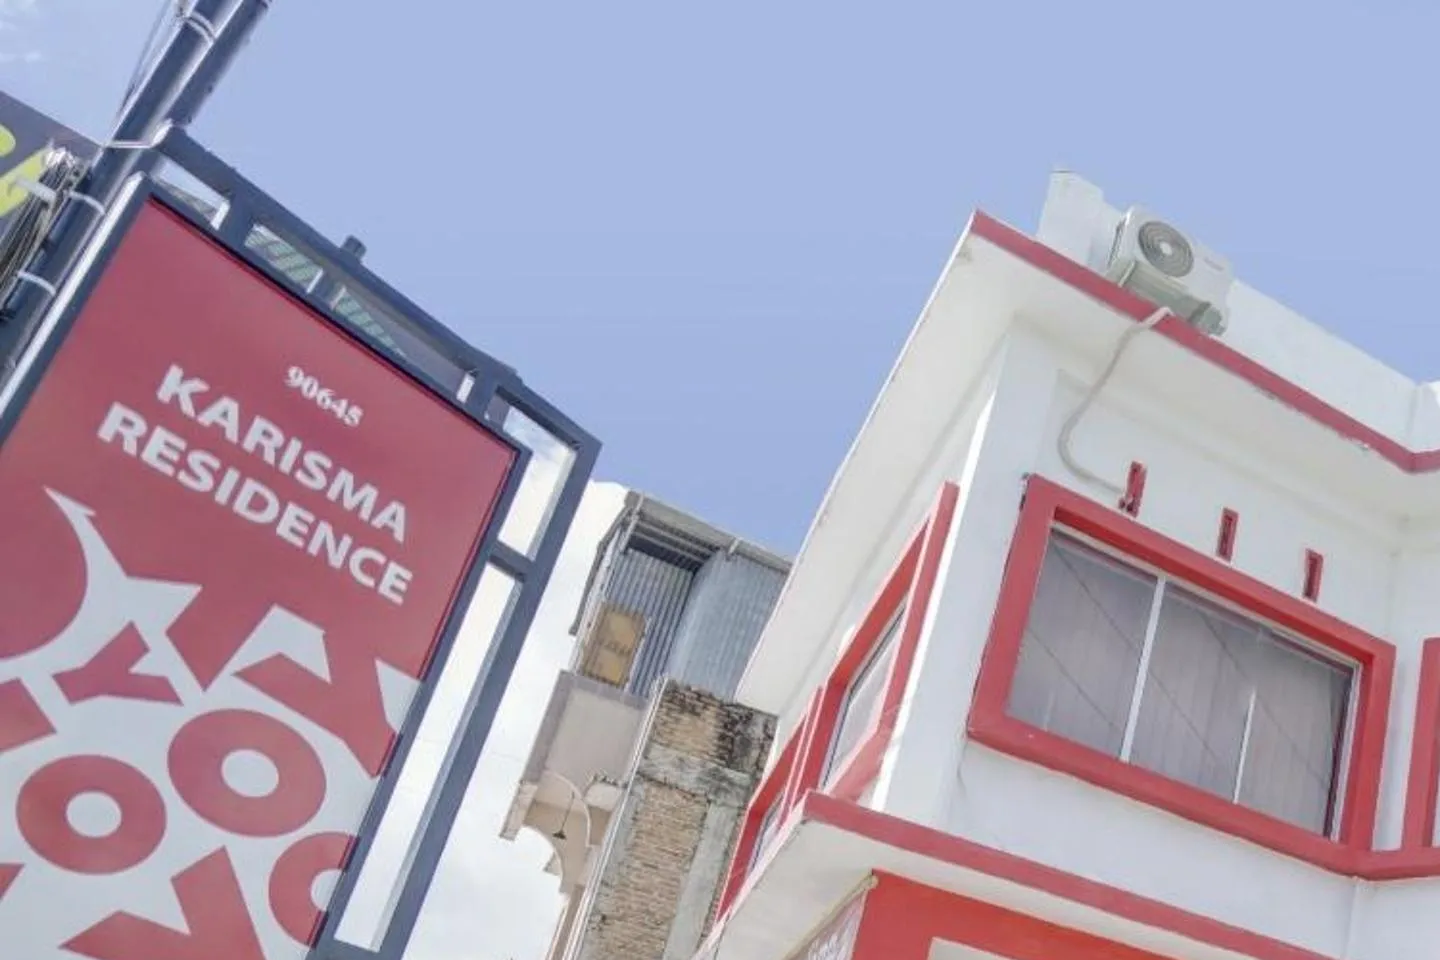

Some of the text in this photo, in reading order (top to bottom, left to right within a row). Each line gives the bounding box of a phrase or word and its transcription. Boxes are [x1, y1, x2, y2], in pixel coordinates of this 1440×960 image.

[156, 364, 407, 545] KARISMA
[286, 365, 364, 427] 90645
[97, 401, 415, 606] RESIDENCE
